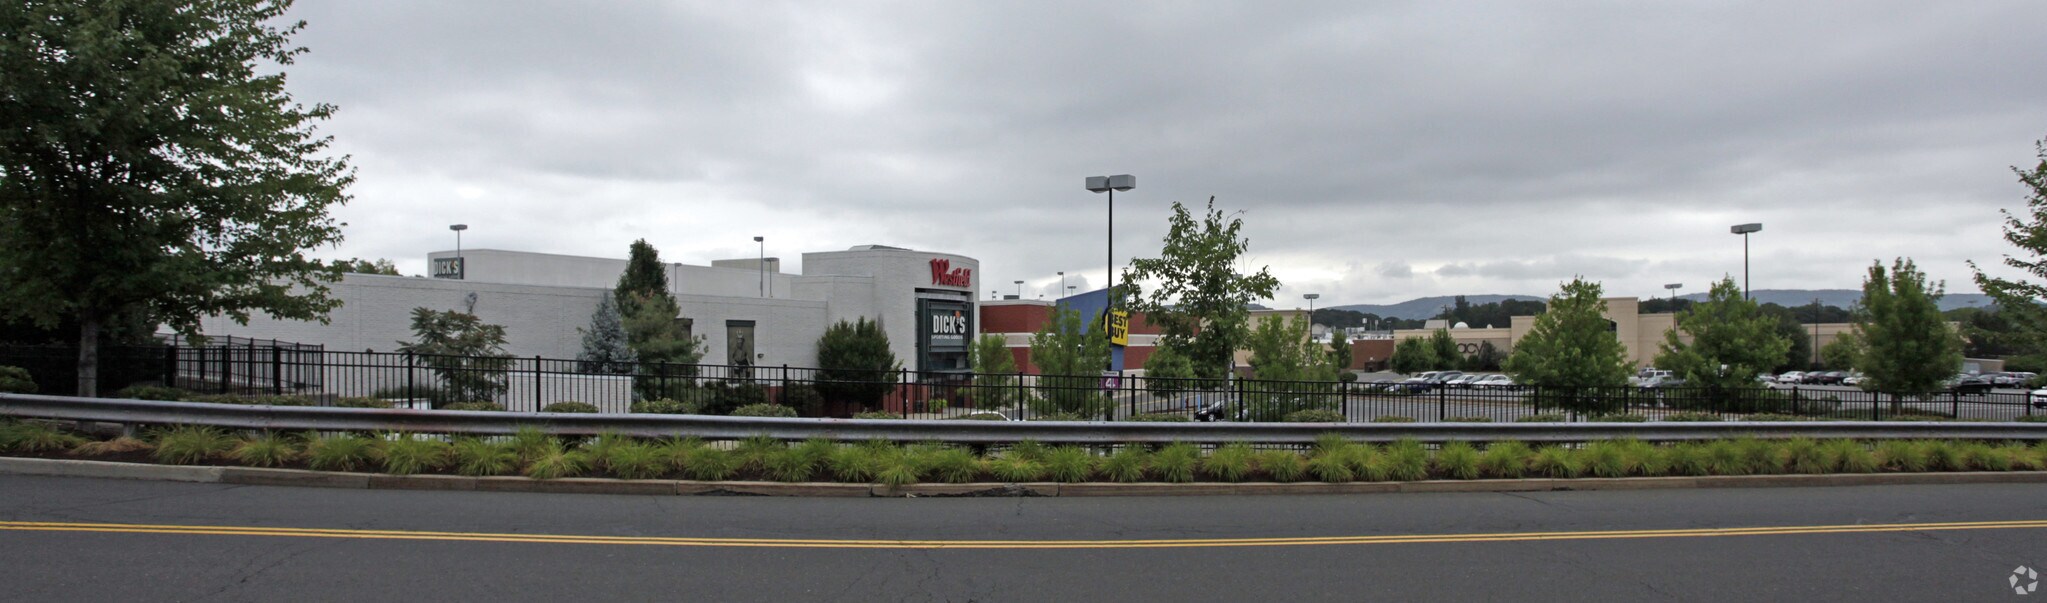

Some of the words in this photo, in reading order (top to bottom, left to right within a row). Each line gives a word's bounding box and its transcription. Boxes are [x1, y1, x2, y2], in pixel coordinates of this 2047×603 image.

[434, 260, 459, 275] DICK'S
[929, 258, 972, 288] Westfield
[932, 312, 966, 334] DICK'S
[1105, 377, 1116, 389] 4
